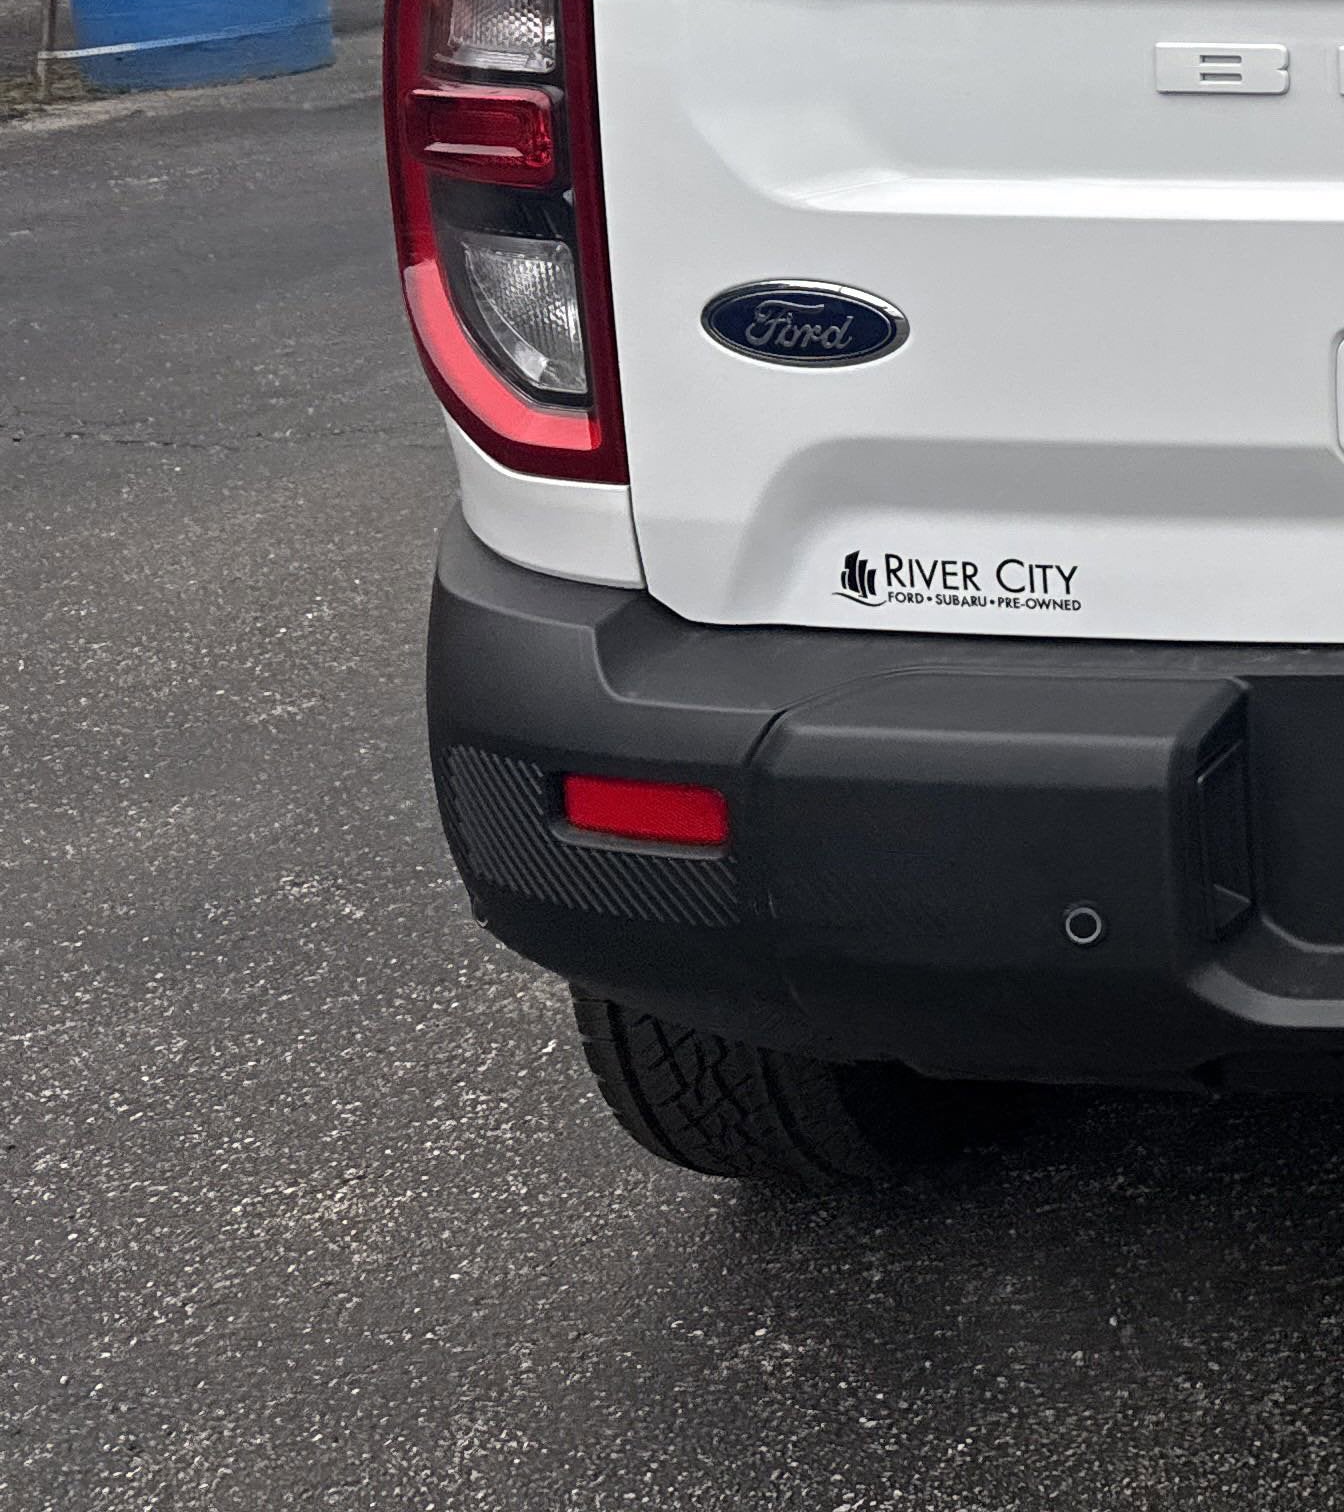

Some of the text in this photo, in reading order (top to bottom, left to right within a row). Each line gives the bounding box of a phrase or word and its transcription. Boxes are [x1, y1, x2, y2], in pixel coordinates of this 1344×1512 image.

[745, 298, 855, 350] Ford
[884, 553, 1079, 595] RIVER CITY
[887, 591, 1082, 612] FORD SUBARU PRE-OWNED
